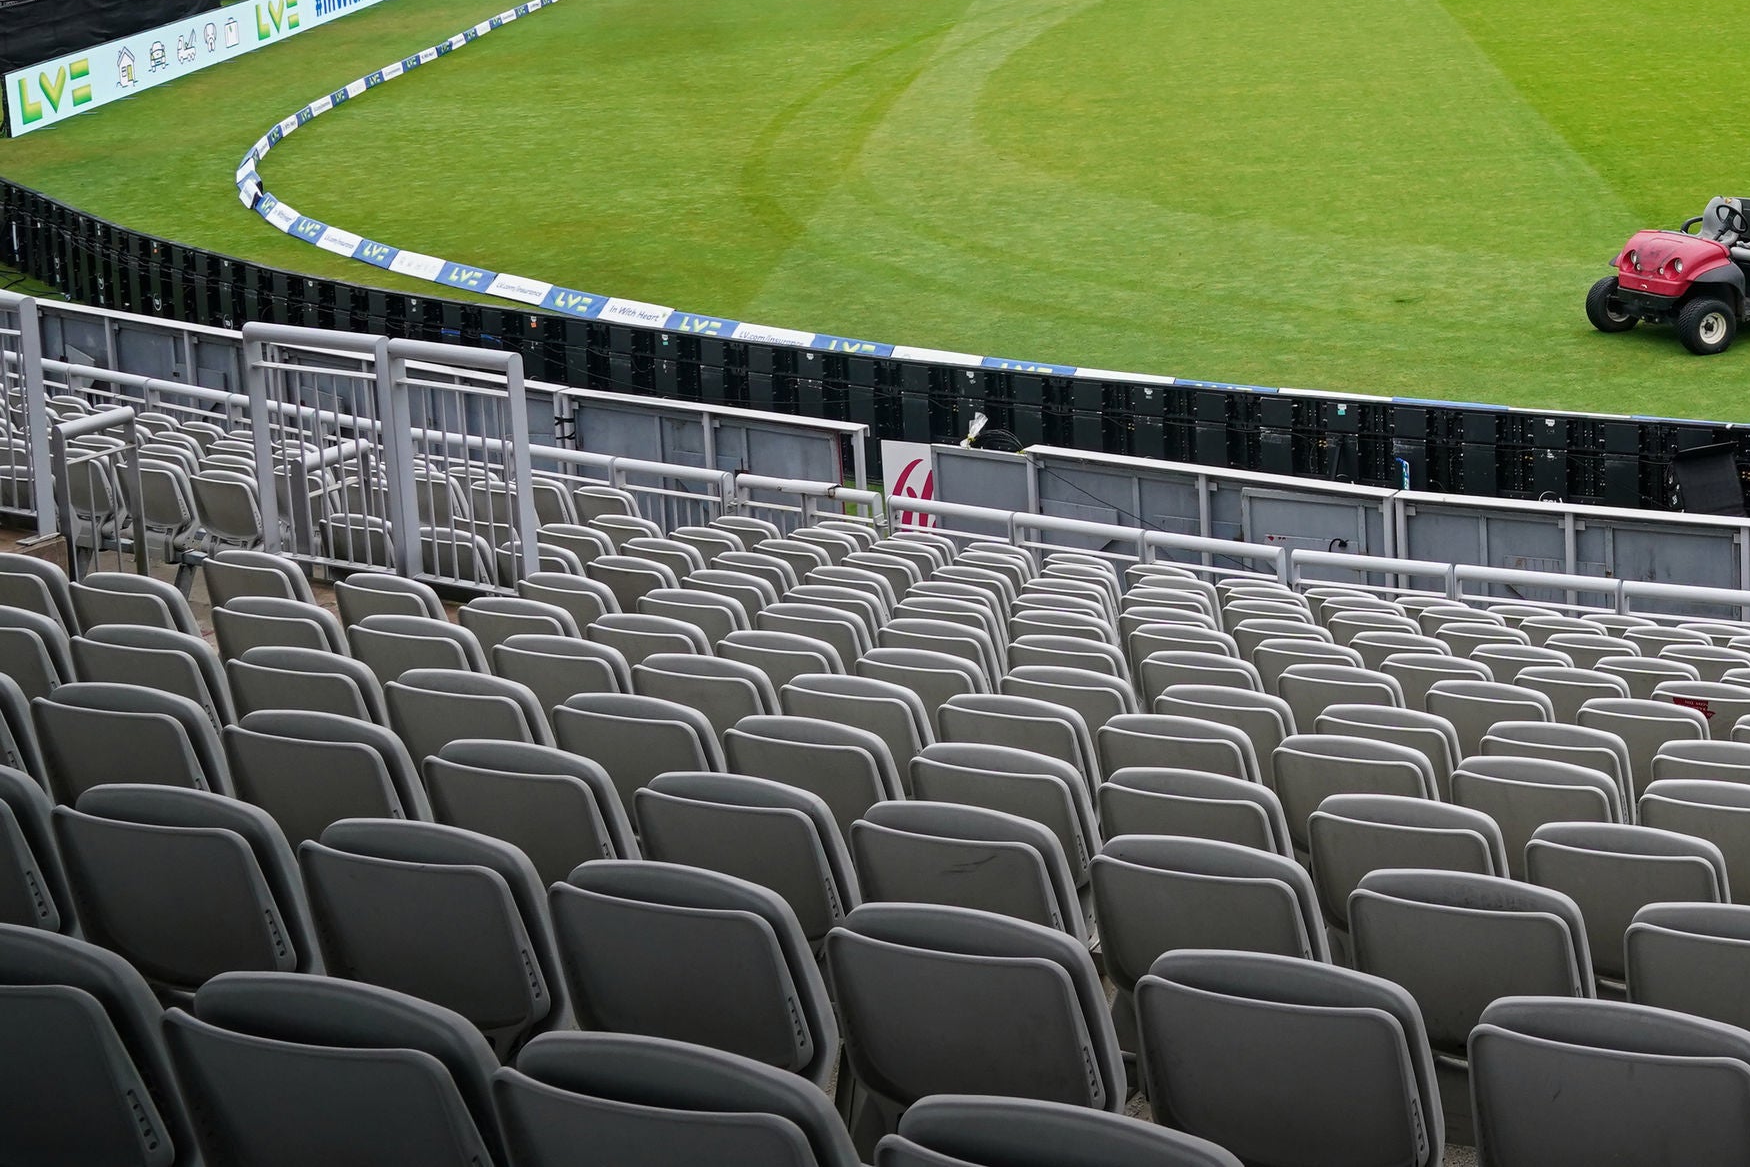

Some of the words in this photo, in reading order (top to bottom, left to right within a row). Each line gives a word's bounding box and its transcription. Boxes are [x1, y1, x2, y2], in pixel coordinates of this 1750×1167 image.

[610, 305, 619, 314] In
[620, 307, 637, 318] With
[637, 311, 659, 322] Heart
